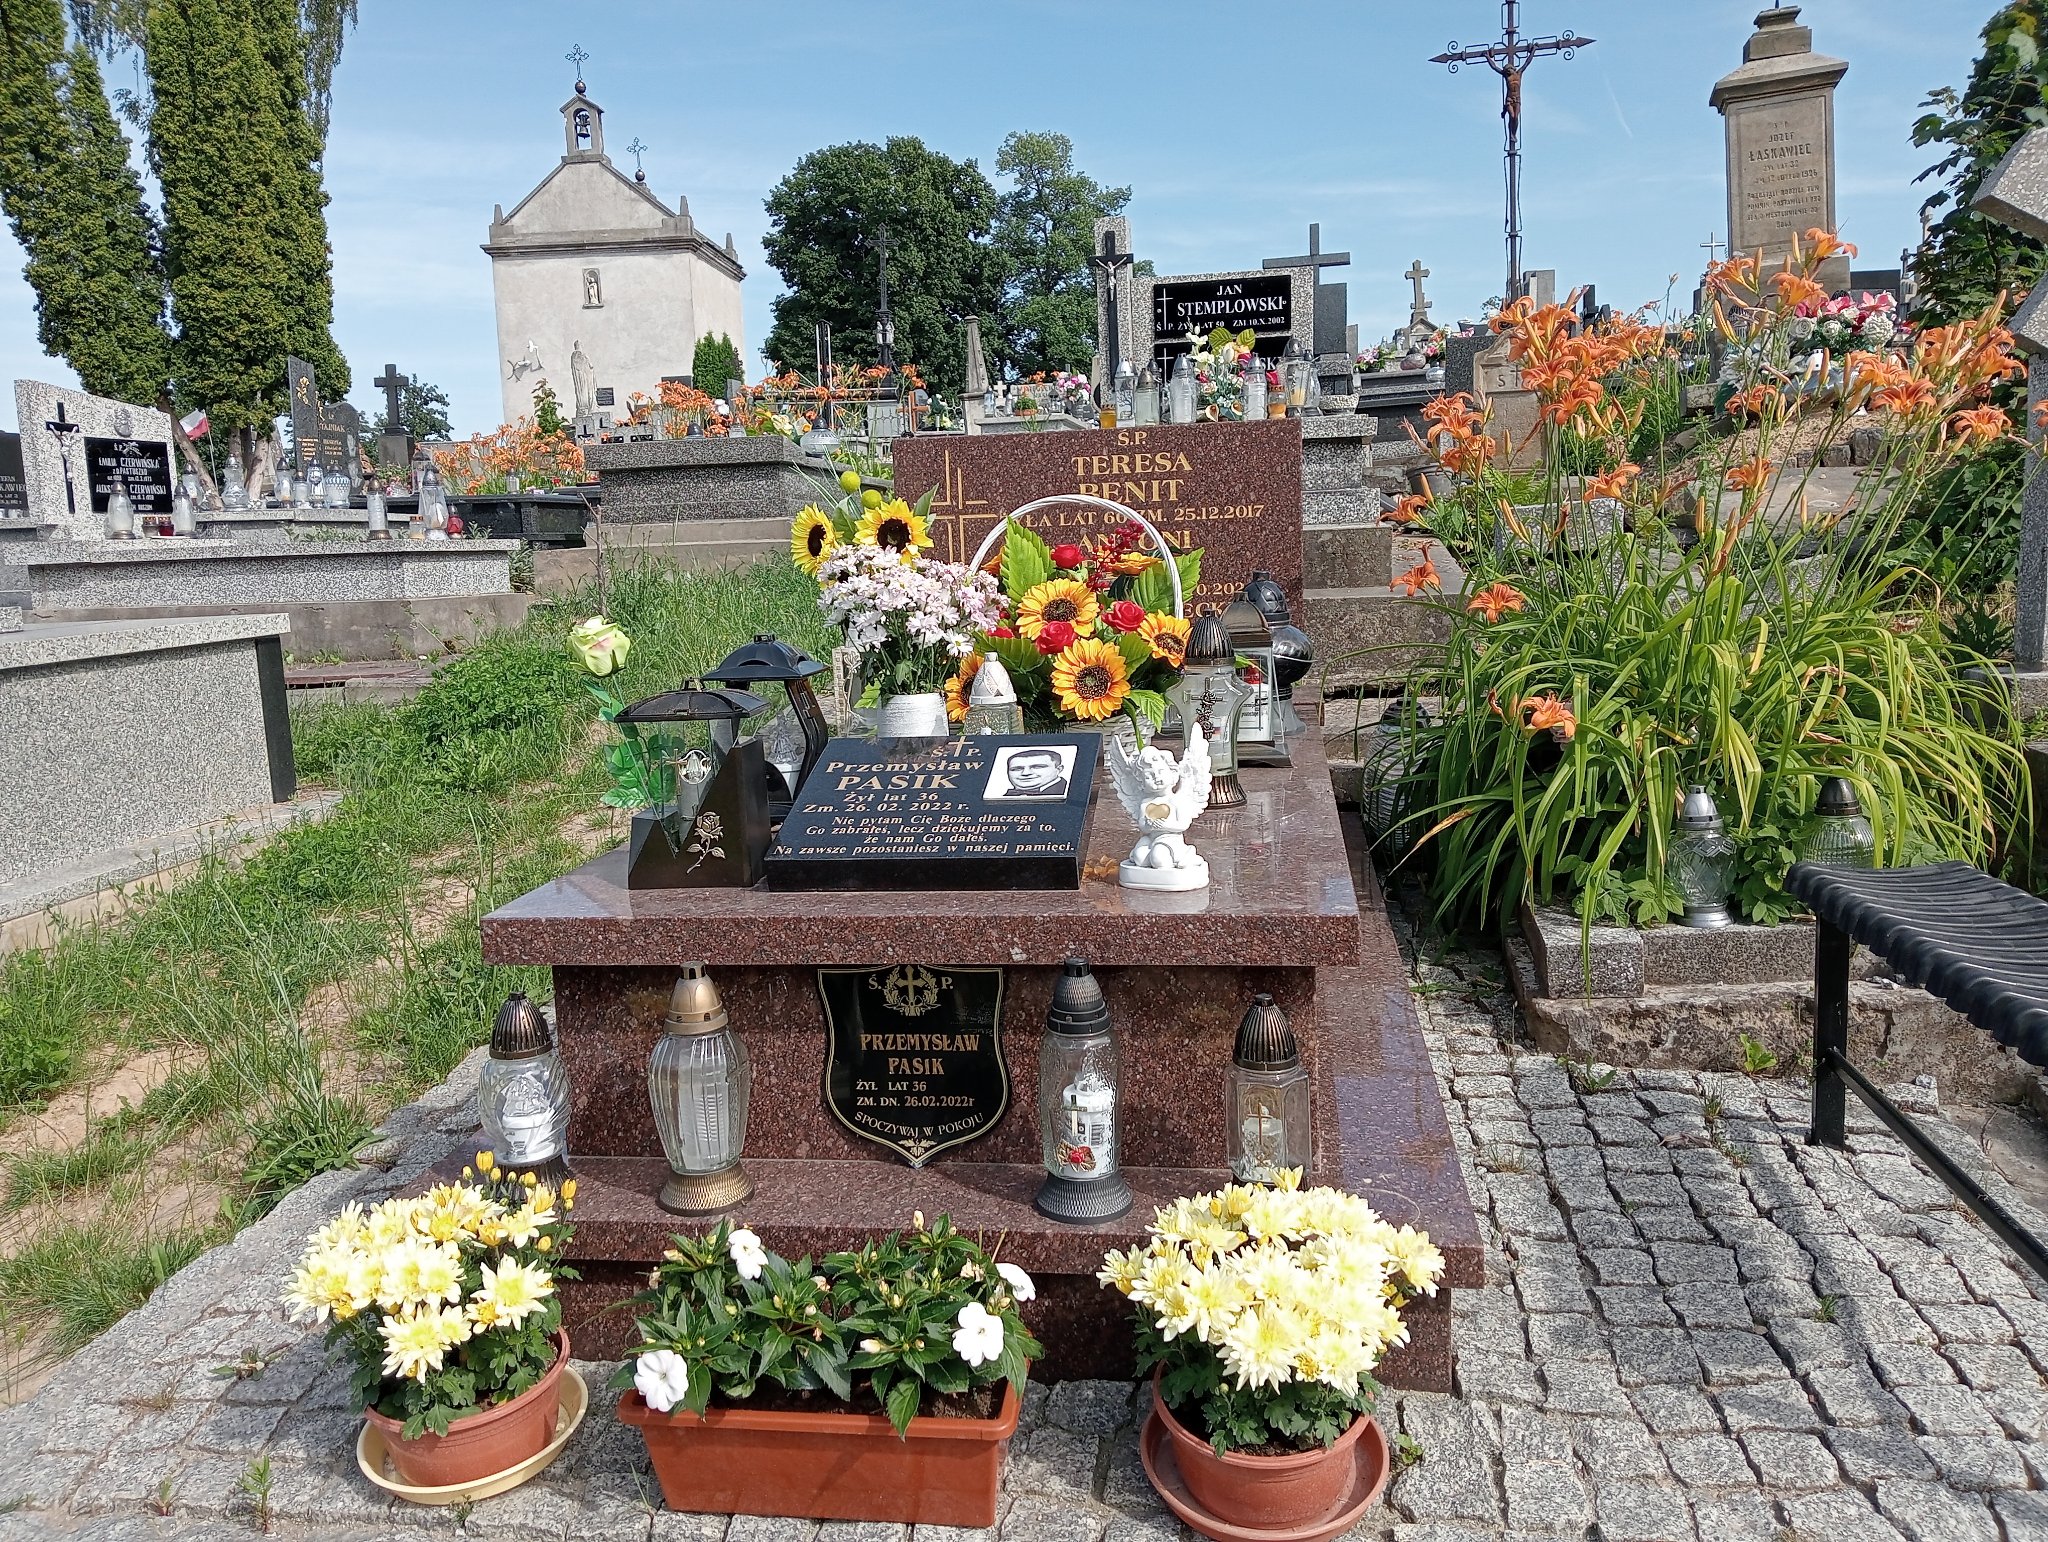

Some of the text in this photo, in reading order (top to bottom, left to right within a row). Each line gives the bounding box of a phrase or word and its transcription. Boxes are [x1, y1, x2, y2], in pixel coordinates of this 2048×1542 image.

[1748, 143, 1812, 162] ŁASKAWIEC
[1216, 284, 1243, 296] JAN
[1117, 430, 1147, 446] Ś.P.
[1071, 451, 1193, 477] TERESA
[1059, 511, 1097, 526] LAT
[1103, 511, 1127, 524] 60
[1174, 504, 1265, 521] 25.12.2017
[966, 747, 982, 757] P.
[825, 760, 985, 774] Przemysław
[834, 774, 960, 791] PASIK
[843, 791, 939, 803] Żył lat 36
[802, 804, 839, 813] Zm.
[844, 803, 871, 812] 26.
[876, 802, 903, 812] 02.
[909, 802, 952, 811] 2022
[832, 814, 1037, 827] Nic pytam Cię Boże dlaczego
[805, 825, 826, 835] Go
[831, 825, 891, 835] zabrałeś,
[898, 825, 925, 834] lecz
[931, 823, 1009, 834] dziękujemy
[863, 832, 988, 844] że nam Go dałeś.
[773, 841, 1076, 856] Na zawsze pozostaniesz w naszej pamięci.
[868, 974, 954, 990] Ś. P.
[860, 1033, 981, 1052] PRZEMYSŁAW
[887, 1057, 945, 1075] PASIK
[855, 1078, 927, 1092] ŻYŁ LAT 36
[856, 1096, 877, 1106] ZM.
[880, 1096, 901, 1107] DN.
[854, 1111, 984, 1138] SPOCZYWAJ W POKOJU
